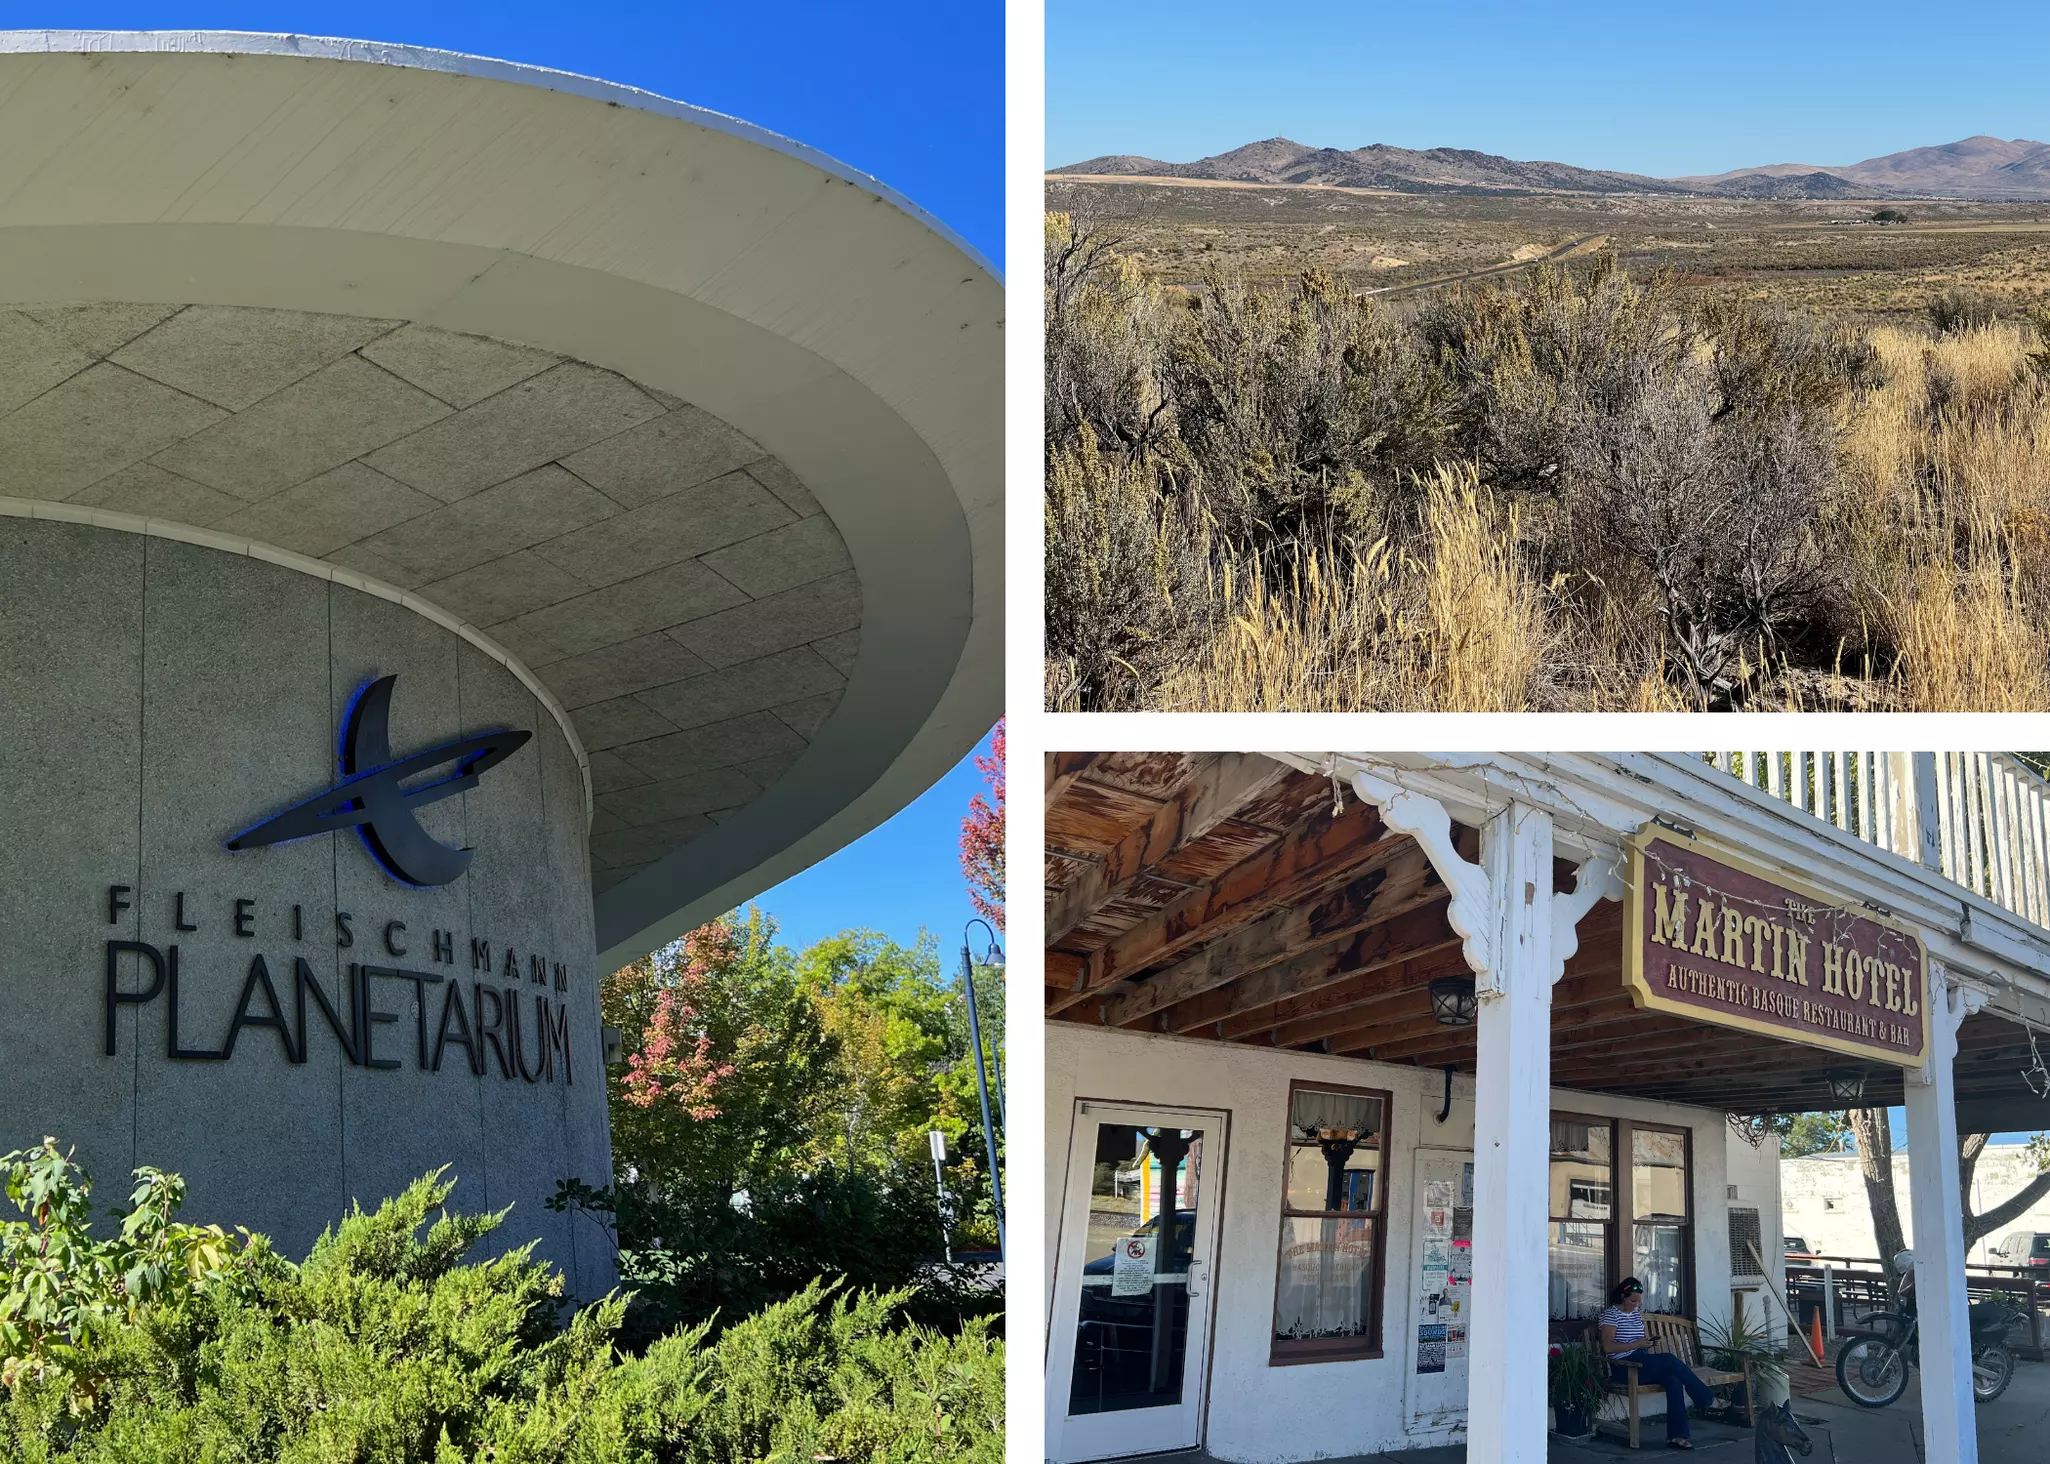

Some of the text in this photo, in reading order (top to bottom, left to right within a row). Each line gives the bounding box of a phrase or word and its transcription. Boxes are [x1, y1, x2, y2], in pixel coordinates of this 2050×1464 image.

[110, 885, 568, 993] FLEISCHMANN
[1651, 881, 1918, 1017] MARTIN HOTEL
[1784, 898, 1816, 925] THE
[106, 940, 573, 1086] PLANETARIUM
[1667, 964, 1910, 1046] AUTHENTIC BASQUE RESTAURANT & BAR
